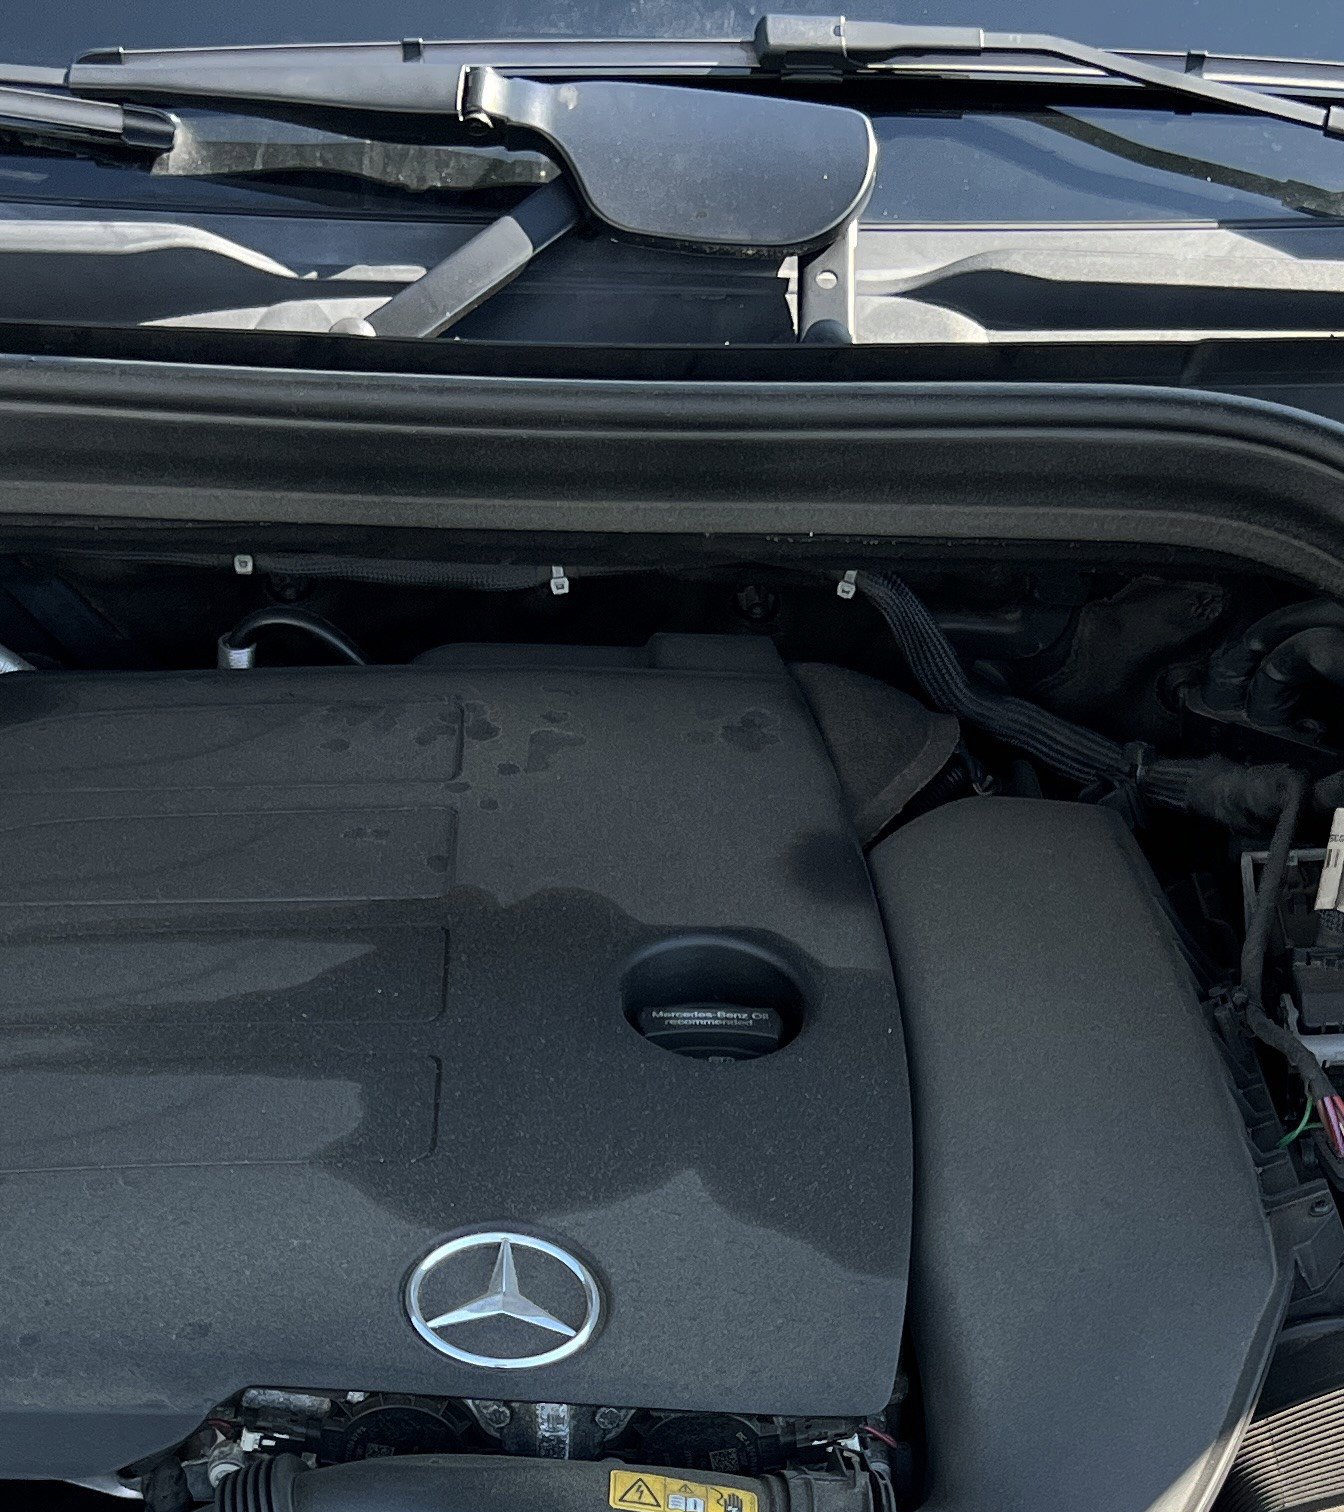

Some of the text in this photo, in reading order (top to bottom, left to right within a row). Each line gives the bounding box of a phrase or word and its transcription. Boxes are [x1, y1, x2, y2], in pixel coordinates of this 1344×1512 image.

[652, 1010, 769, 1020] Mercedes-Benz Oil
[664, 1018, 753, 1027] recommended
